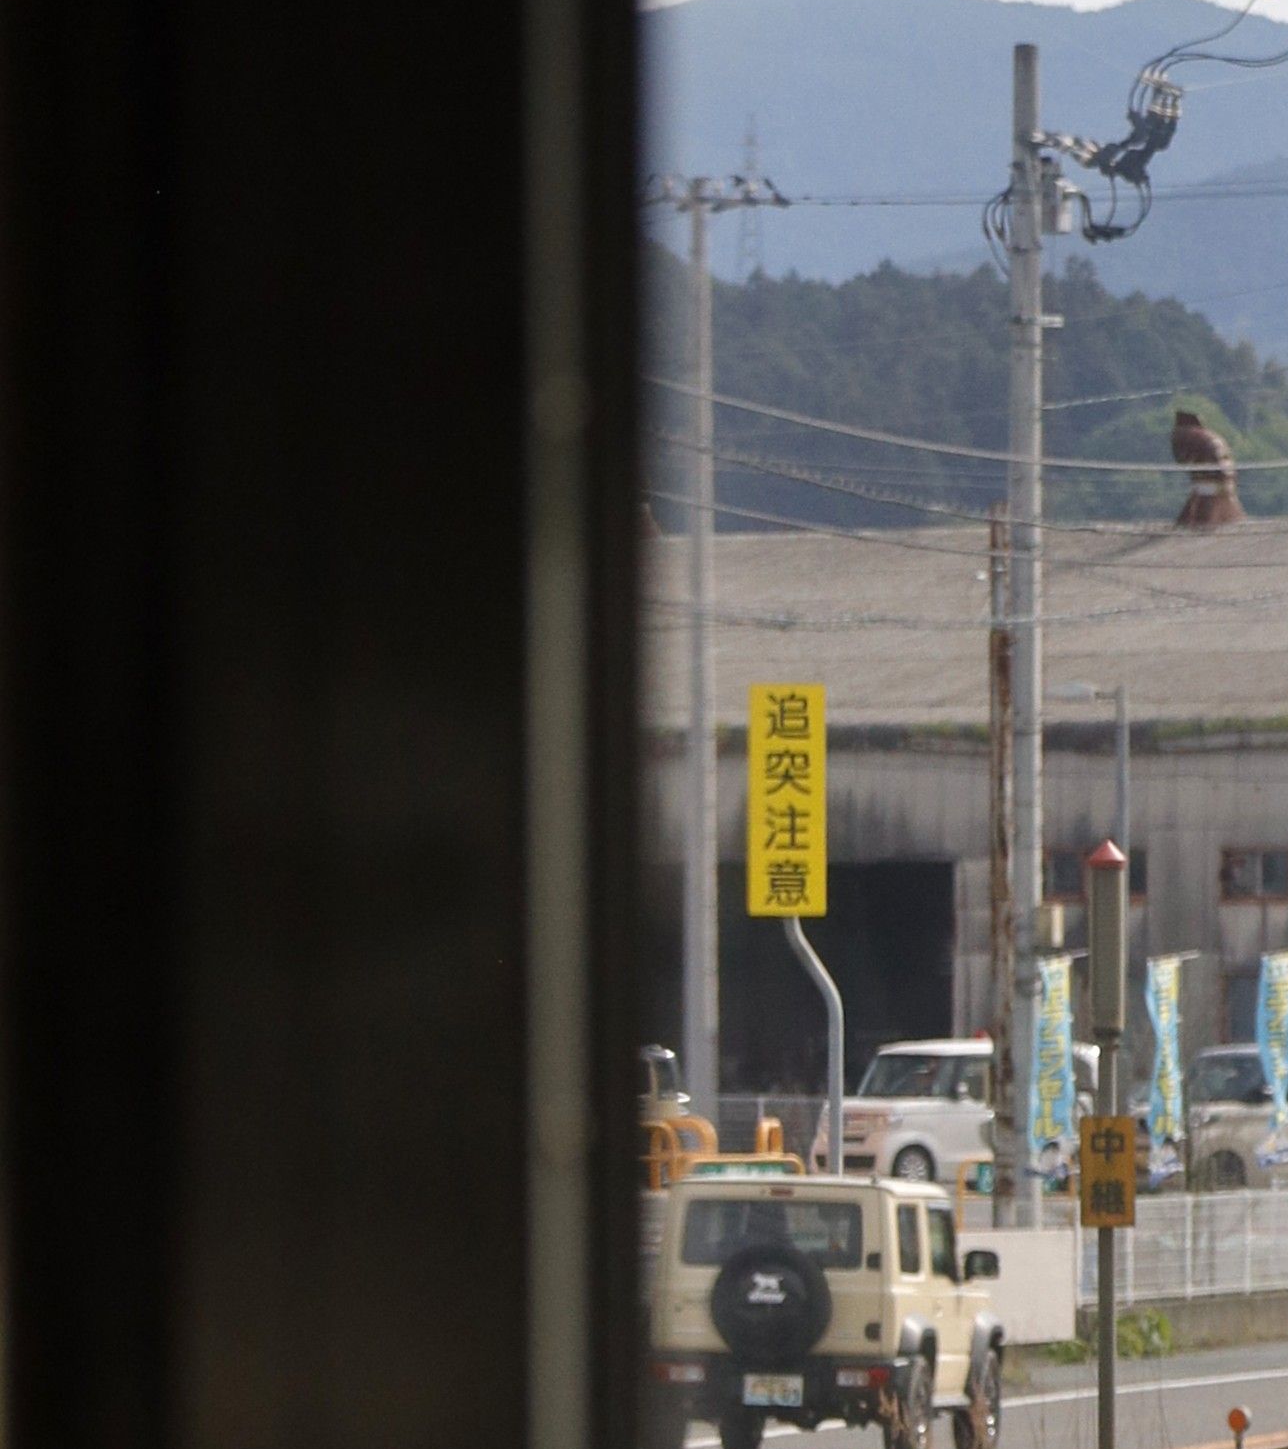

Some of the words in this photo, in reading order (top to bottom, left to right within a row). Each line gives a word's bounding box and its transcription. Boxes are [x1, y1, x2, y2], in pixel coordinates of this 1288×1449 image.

[764, 692, 811, 906] 追突注意
[1090, 1128, 1128, 1216] 中継
